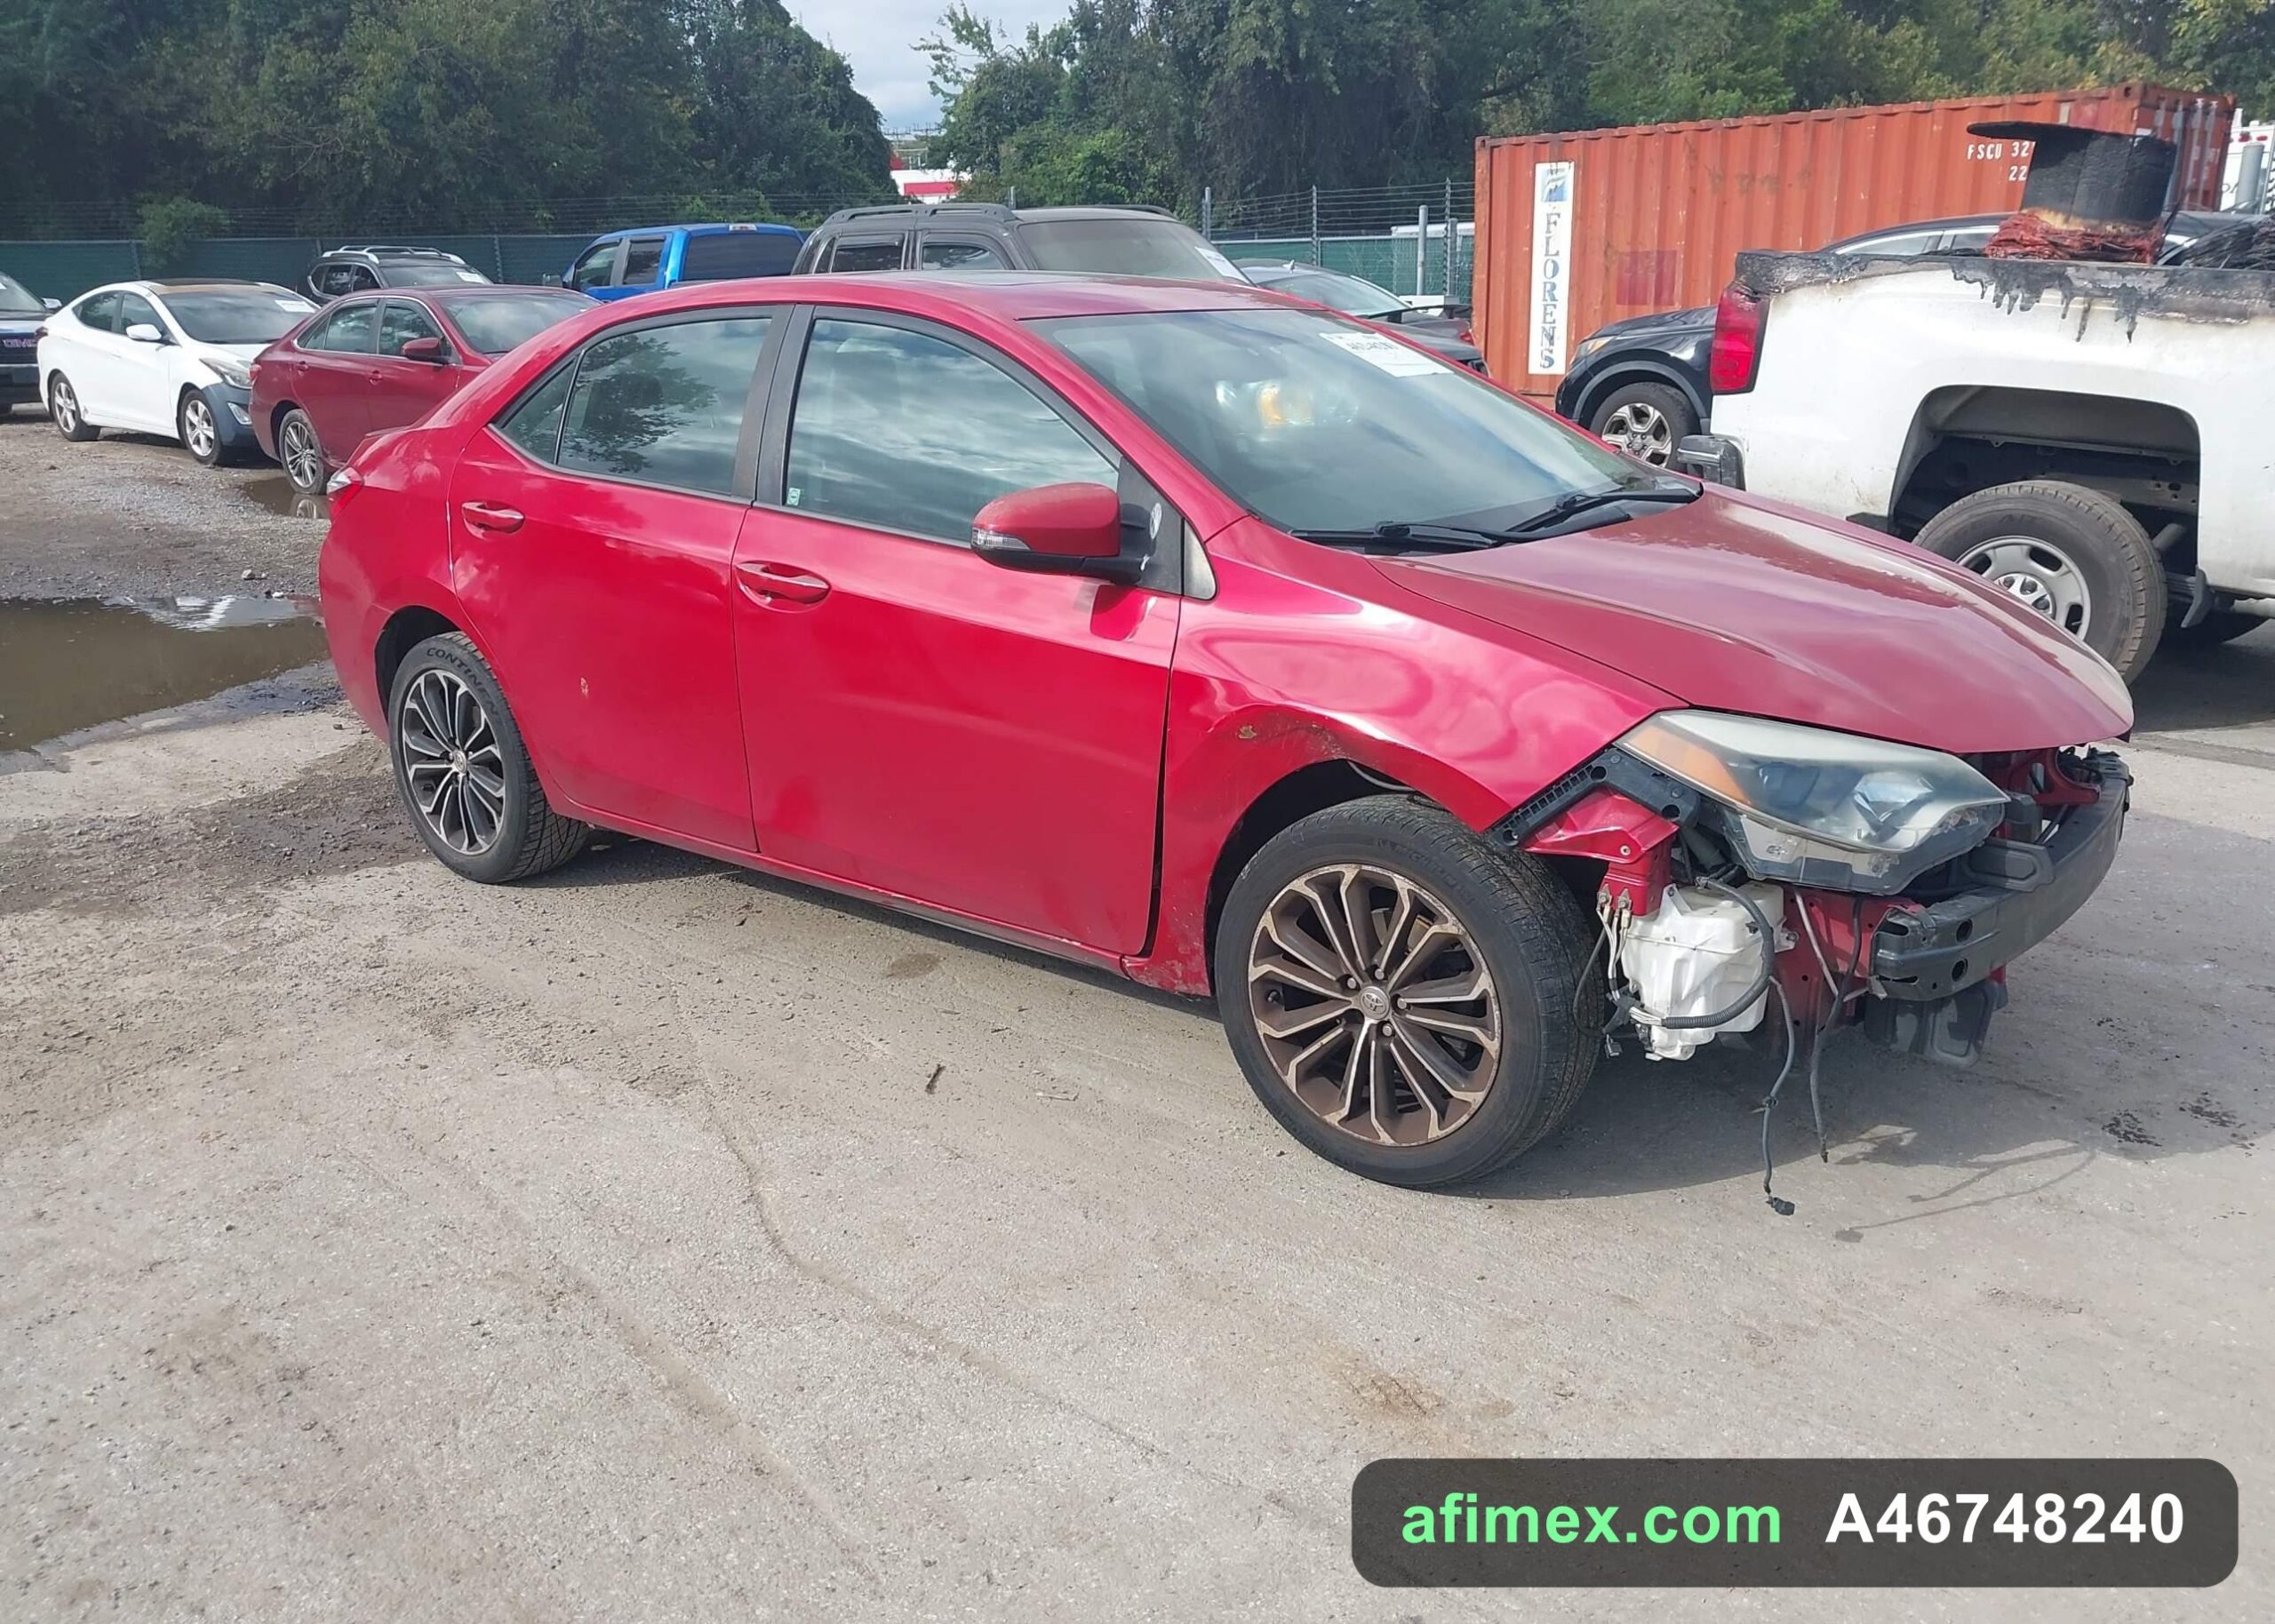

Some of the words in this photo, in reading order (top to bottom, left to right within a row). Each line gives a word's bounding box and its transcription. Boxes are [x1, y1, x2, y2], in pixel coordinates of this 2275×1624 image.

[1967, 142, 2003, 161] FSCU
[2011, 140, 2037, 158] 32
[2008, 165, 2028, 182] 22
[1539, 212, 1561, 370] FLORENS
